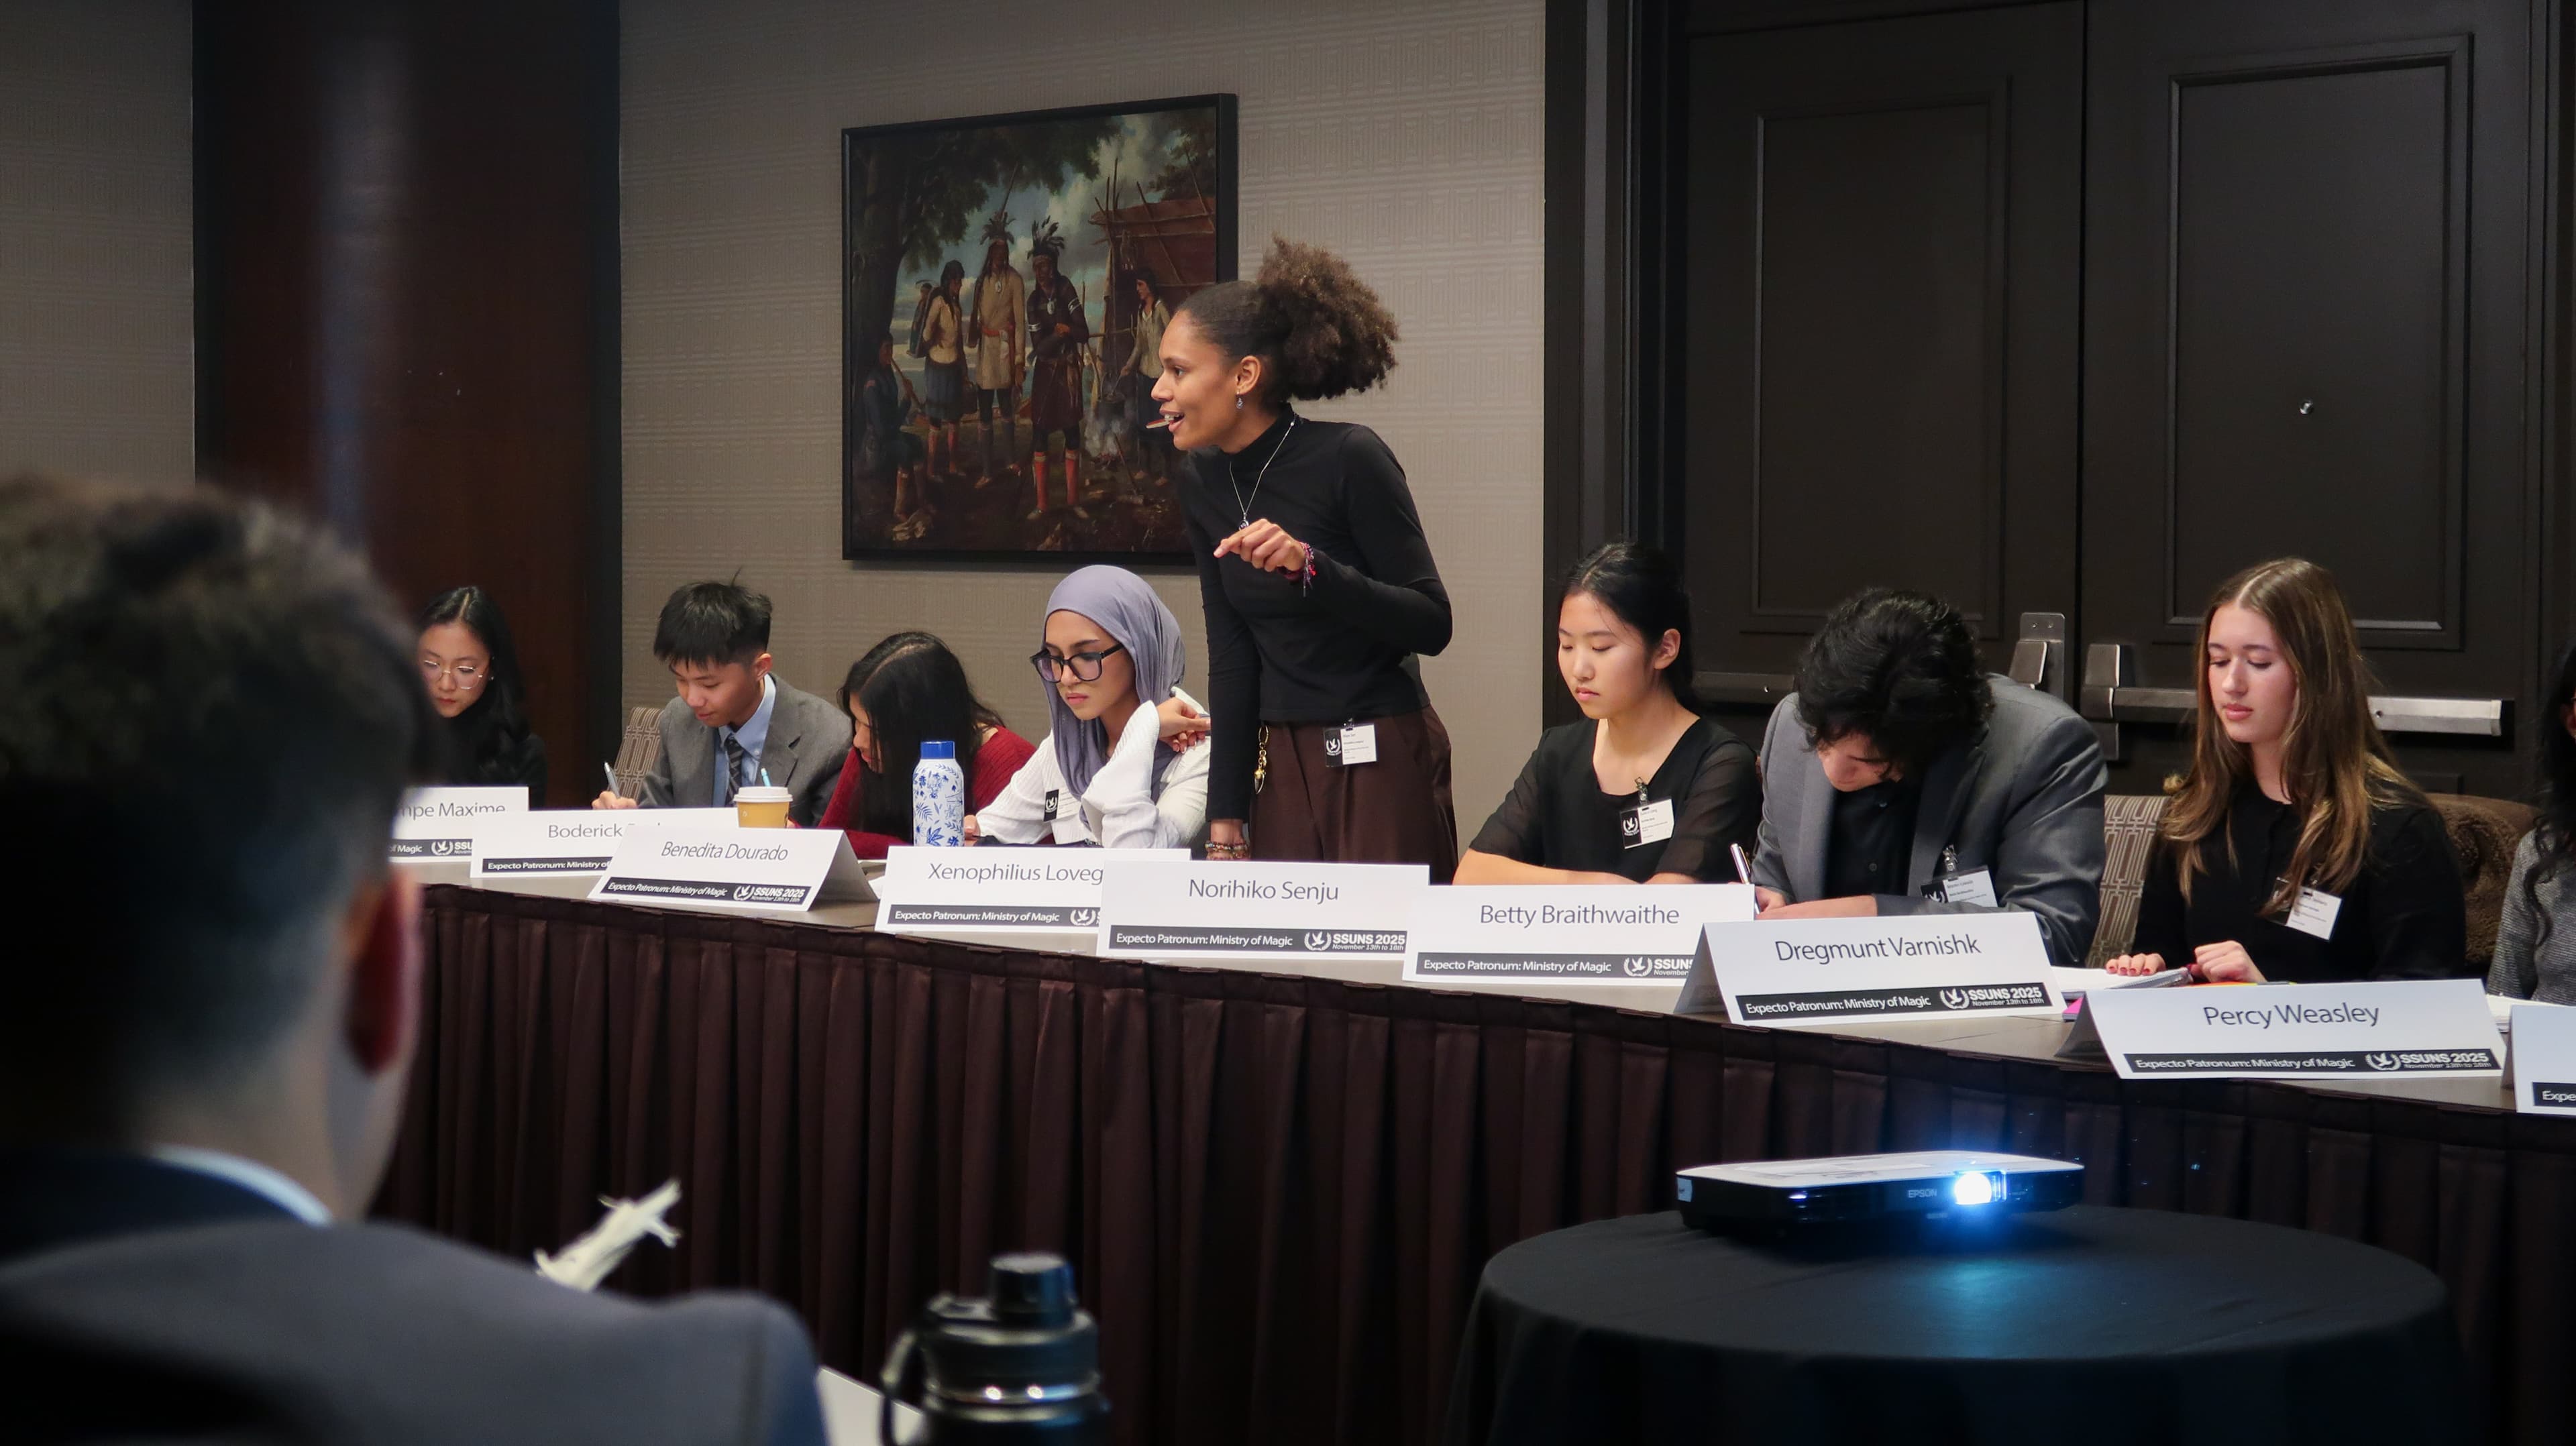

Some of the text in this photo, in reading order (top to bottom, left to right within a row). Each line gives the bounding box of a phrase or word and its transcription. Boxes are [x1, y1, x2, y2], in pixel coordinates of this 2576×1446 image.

[438, 802, 506, 818] Maxime
[547, 824, 623, 838] Boderick
[397, 845, 423, 854] Magic
[661, 841, 789, 861] Benedita Dourado
[488, 863, 522, 871] Expecto
[522, 862, 566, 870] Patronum:
[566, 861, 600, 871] Ministry
[928, 863, 1104, 886] Xenophilius Loveg
[608, 882, 728, 898] Expecto Patronum: Ministry of Magic
[753, 887, 806, 898] SSUNS 2025
[1189, 879, 1340, 905] Norihiko Senju
[894, 911, 1060, 924] Expecto Patronum: Ministry of Magic
[1480, 903, 1680, 929] Betty Braithwaithe
[1116, 933, 1293, 948] Expecto Patronum: Ministry of Magic
[1332, 933, 1405, 945] SSUNS 2025
[1775, 933, 1982, 965] Dregmunt Varnishk
[1424, 959, 1612, 974] Expecto Patronum: Ministry of Magic
[1968, 987, 2043, 1001] SSUNS 2025
[1746, 995, 1931, 1015] Expecto Patronum: Ministry of Magic
[1972, 999, 2006, 1007] November
[2203, 1001, 2379, 1030] Percy Weasley
[2135, 1058, 2356, 1069] Expecto Patronum: Ministry of Magic
[2399, 1052, 2489, 1064] SSUNS 2025
[2542, 1090, 2576, 1103] Expe
[1907, 1188, 1938, 1199] EPSON
